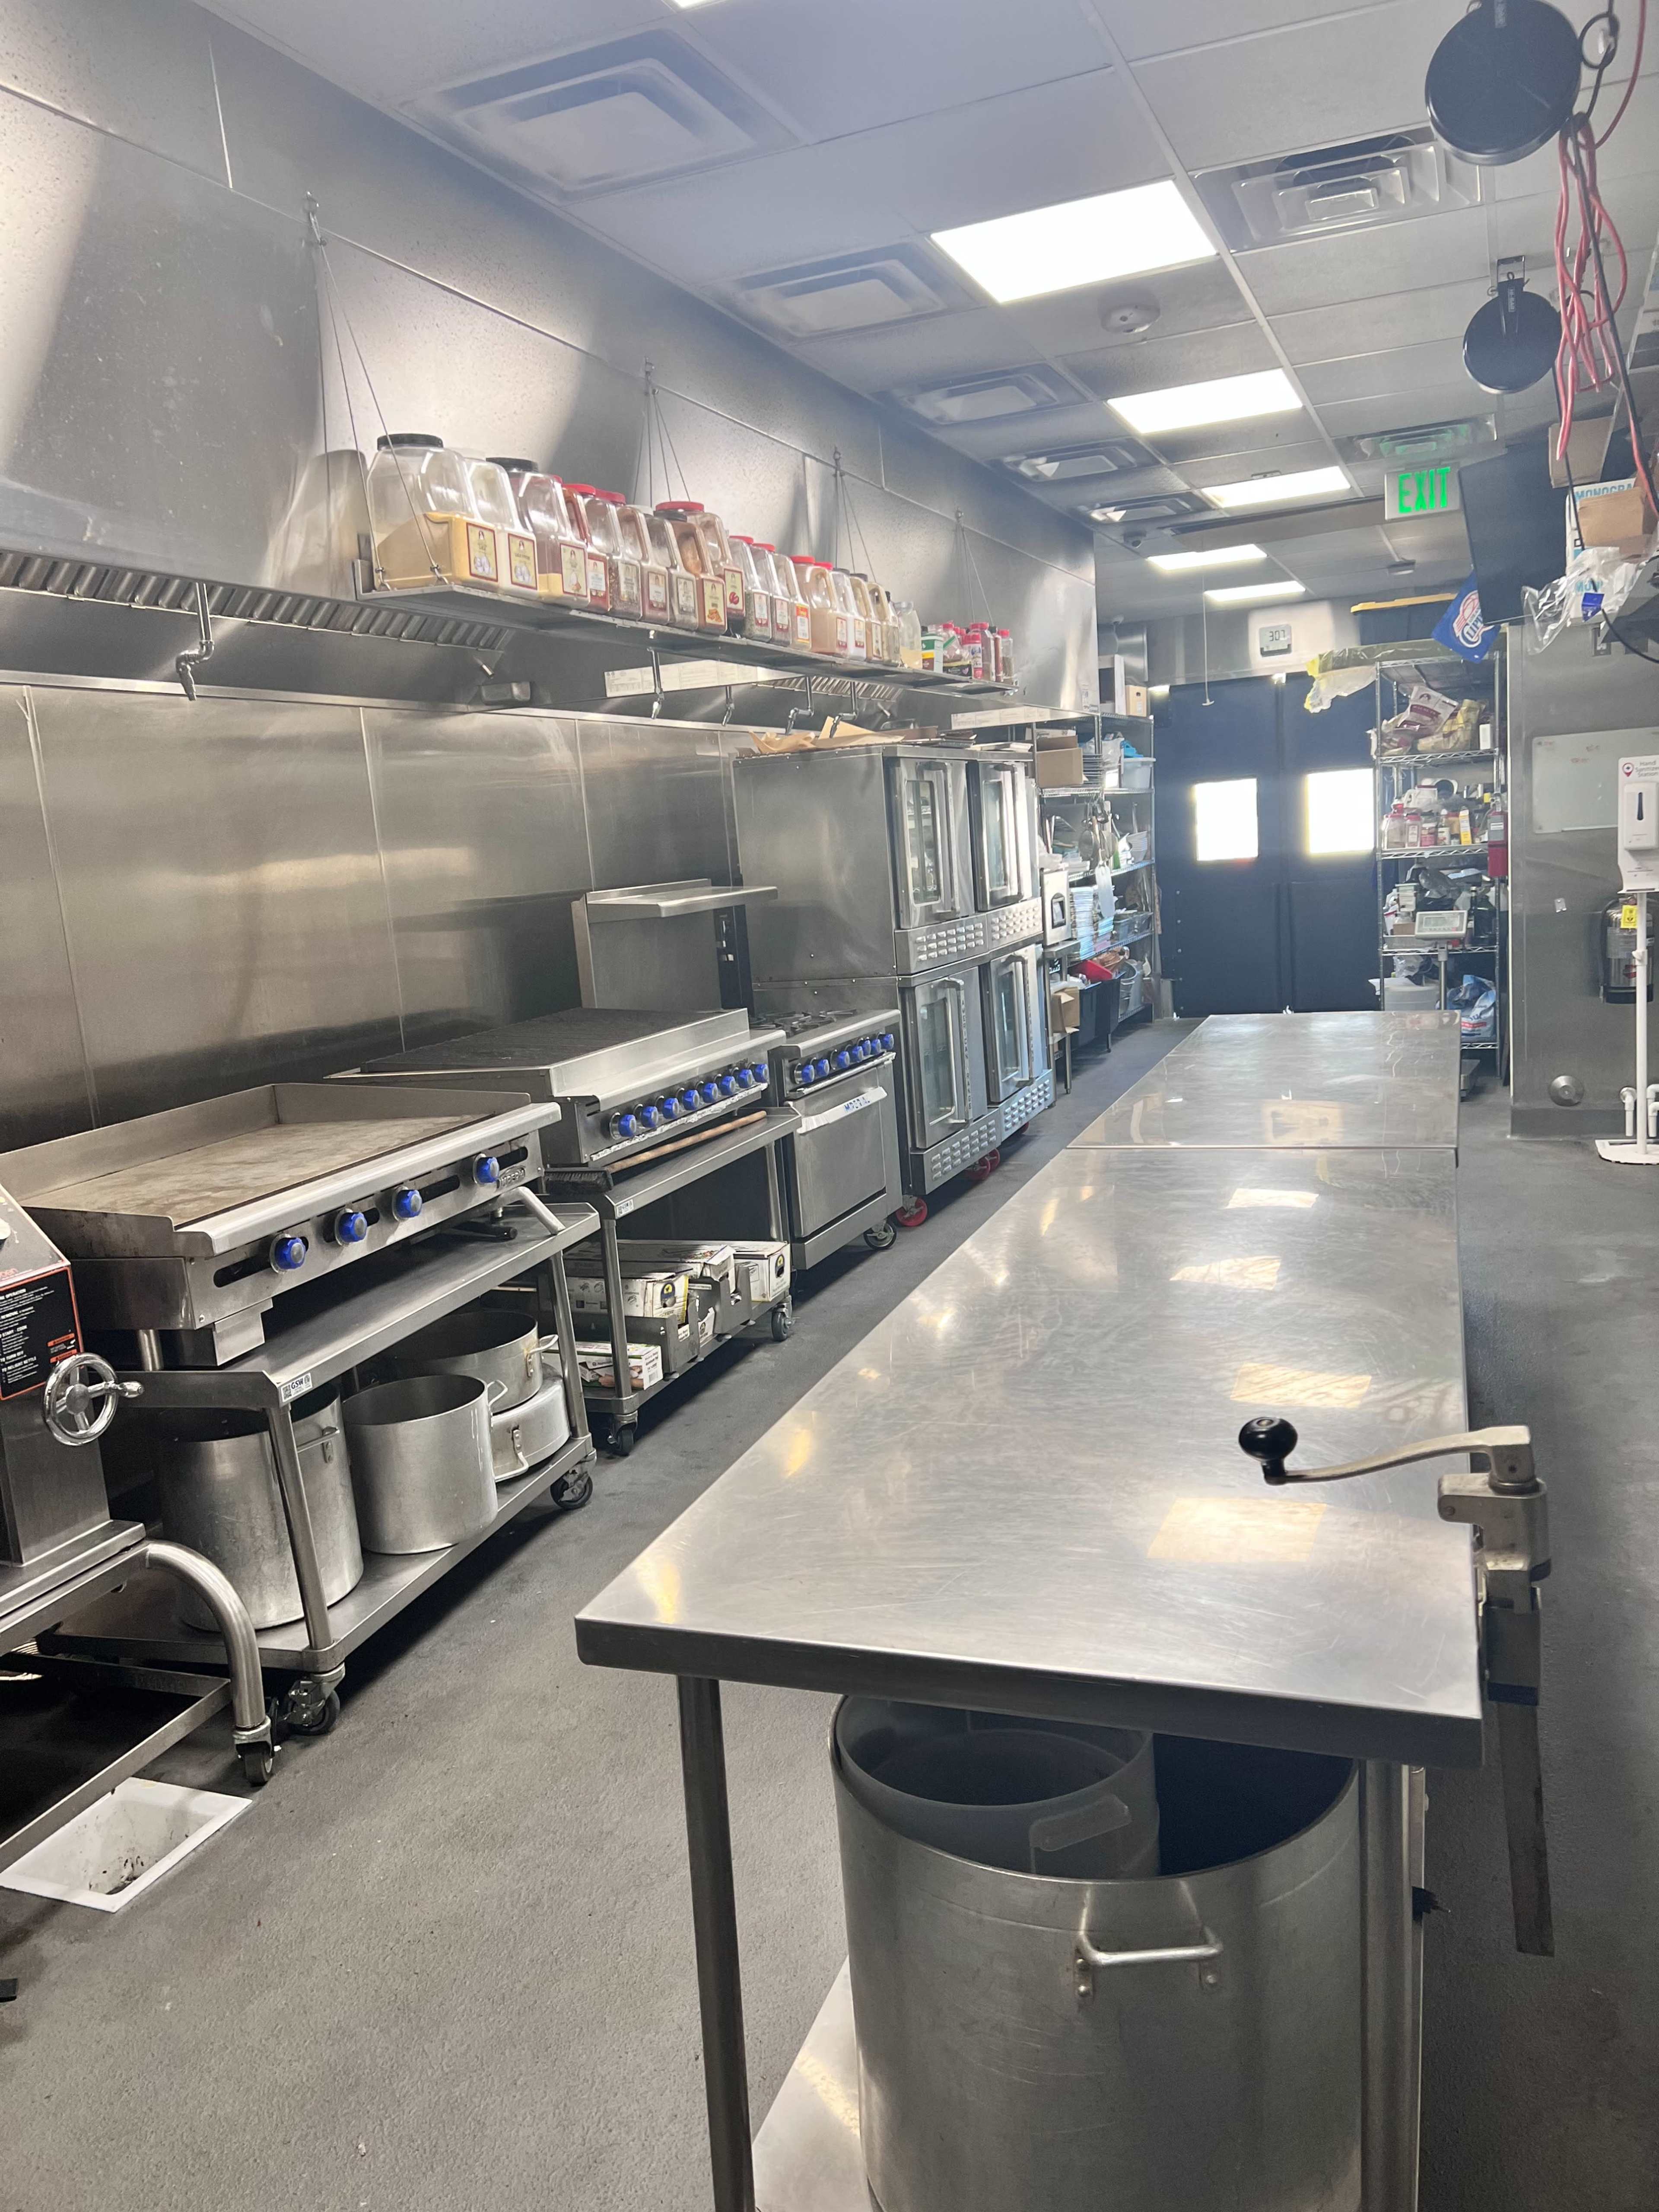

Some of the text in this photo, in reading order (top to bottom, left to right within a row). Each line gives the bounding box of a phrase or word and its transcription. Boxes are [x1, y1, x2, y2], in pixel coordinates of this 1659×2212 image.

[1398, 467, 1450, 513] EXIT
[1575, 483, 1633, 501] MONOGRA
[291, 1378, 303, 1389] GSW
